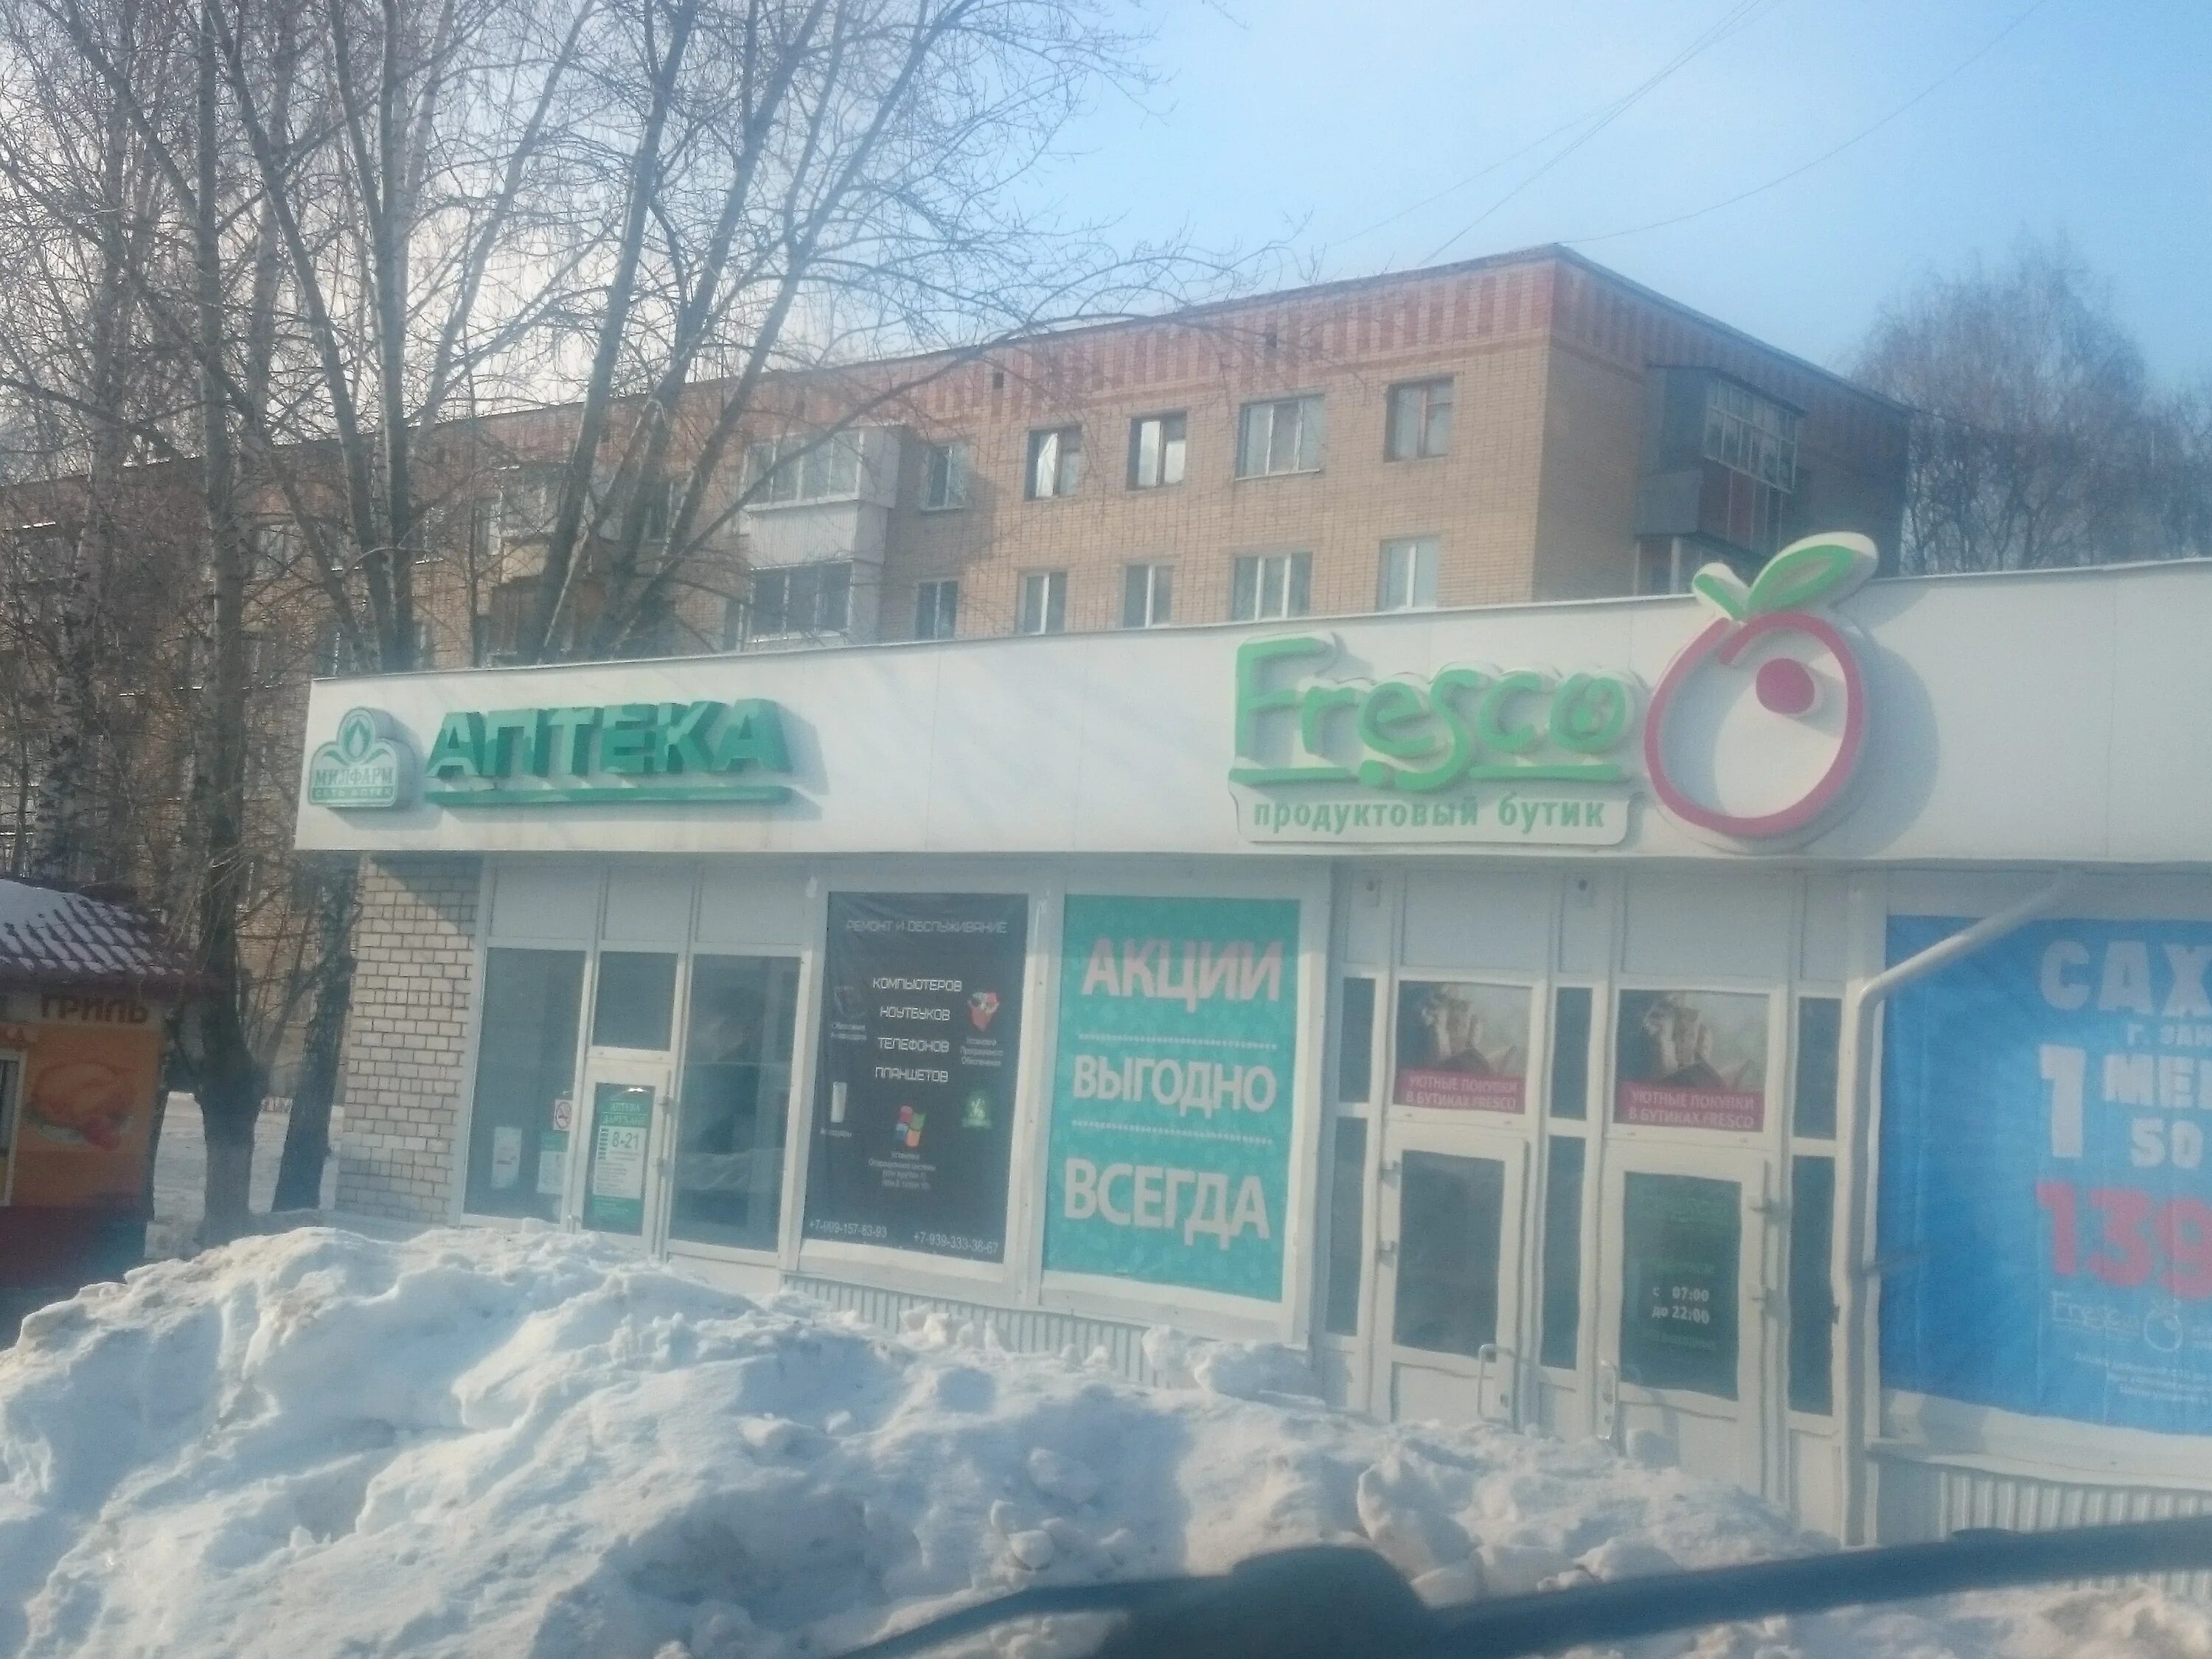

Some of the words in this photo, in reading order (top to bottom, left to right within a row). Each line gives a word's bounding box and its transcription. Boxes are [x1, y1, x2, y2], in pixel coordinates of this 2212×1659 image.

[1236, 636, 1629, 791] Fresco
[425, 698, 793, 779] АПТЕКА
[315, 767, 393, 786] МИЛФАРМ
[316, 790, 345, 799] СЕТЬ
[351, 788, 392, 798] АПТЕК
[1253, 801, 1477, 835] продуктовый
[1498, 793, 1605, 834] бутик
[846, 920, 891, 932] РЕМОНТ
[896, 920, 905, 932] И
[908, 920, 1008, 933] ОБСЛУЖИВАНИЕ
[1080, 936, 1284, 1012] АКЦИИ
[2039, 940, 2212, 1018] САХ
[873, 978, 962, 992] КОМПЬЮТЕРОВ
[41, 996, 147, 1023] ГРИЛЬ
[880, 1006, 950, 1021] НОУТБУКОВ
[877, 1037, 950, 1053] ТЕЛЕФОНОВ
[875, 1067, 949, 1082] ПЛАНШЕТОВ
[1409, 1074, 1458, 1090] УЮТНЫЕ
[1073, 1054, 1276, 1118] ВЫГОДНО
[1406, 1091, 1413, 1102] В
[1632, 1091, 1688, 1107] УЮТНЫЕ
[1691, 1094, 1753, 1110] ПОКУПКИ
[2040, 1044, 2085, 1158] 1
[1628, 1107, 1637, 1119] В
[1641, 1108, 1700, 1124] БУТИКАХ
[613, 1132, 639, 1150] 8-21
[2131, 1117, 2202, 1169] 50
[1064, 1157, 1270, 1251] ВСЕГДА
[2036, 1180, 2212, 1300] 139
[1672, 1286, 1709, 1302] 07:00
[1652, 1306, 1669, 1318] до
[1672, 1305, 1710, 1324] 22:00
